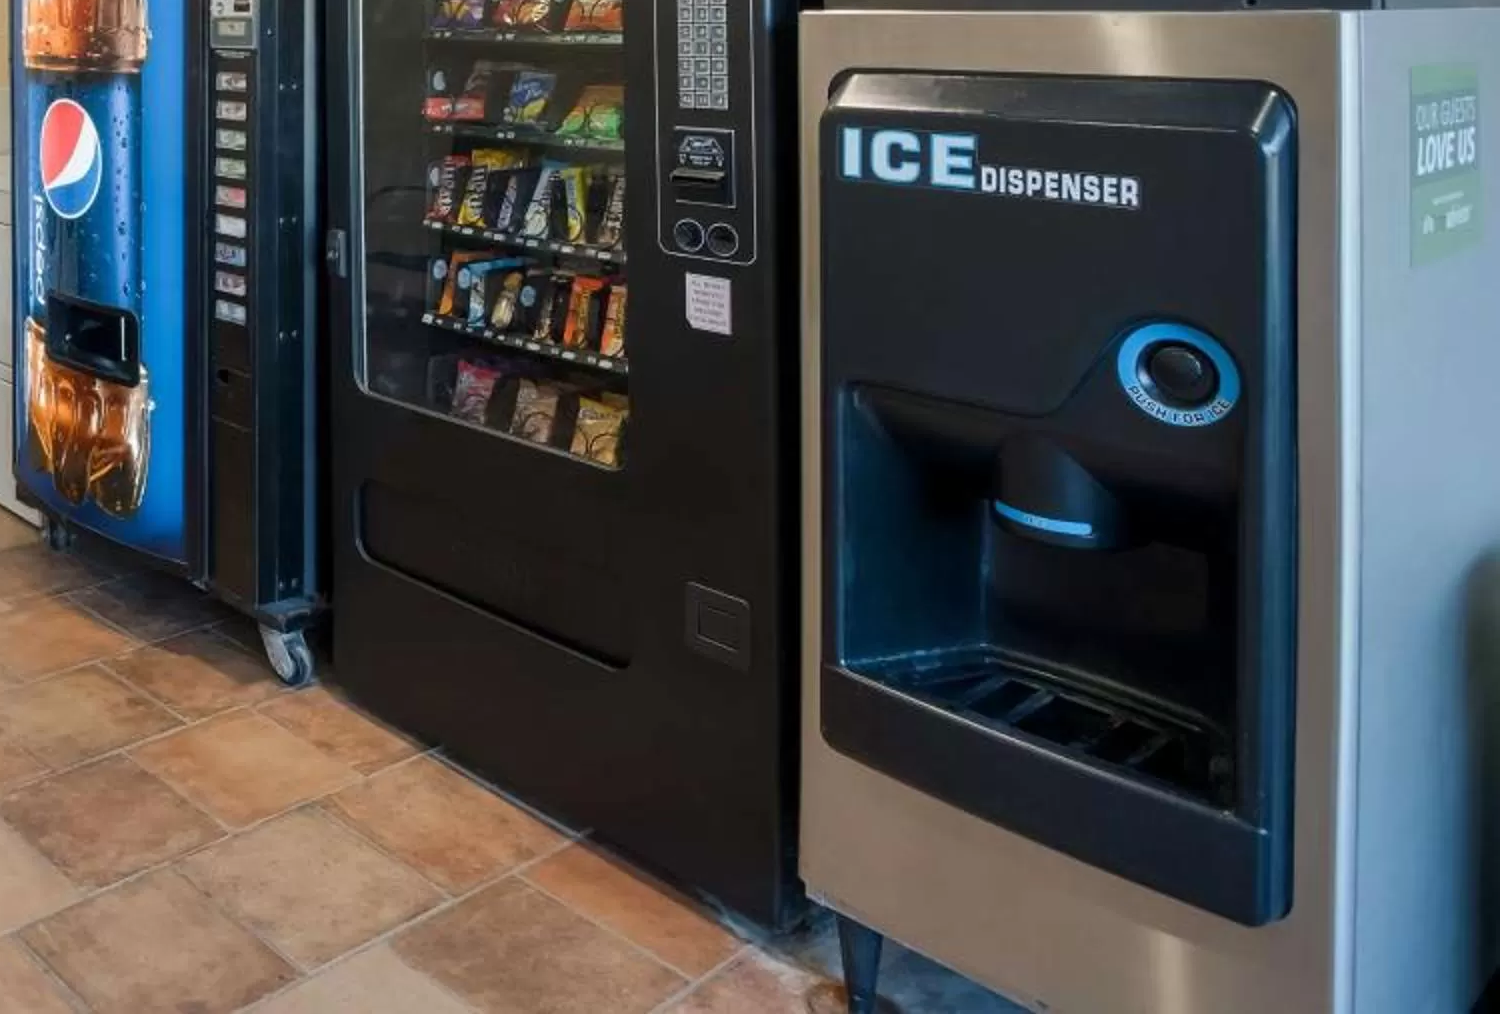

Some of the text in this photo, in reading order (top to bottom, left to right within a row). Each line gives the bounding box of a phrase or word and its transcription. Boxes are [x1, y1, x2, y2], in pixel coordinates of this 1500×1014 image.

[843, 127, 1140, 207] ICE DISPENSER
[1417, 126, 1476, 176] LOVE US
[33, 194, 46, 305] pepsi
[1127, 385, 1231, 424] PUSH FOR ICE
